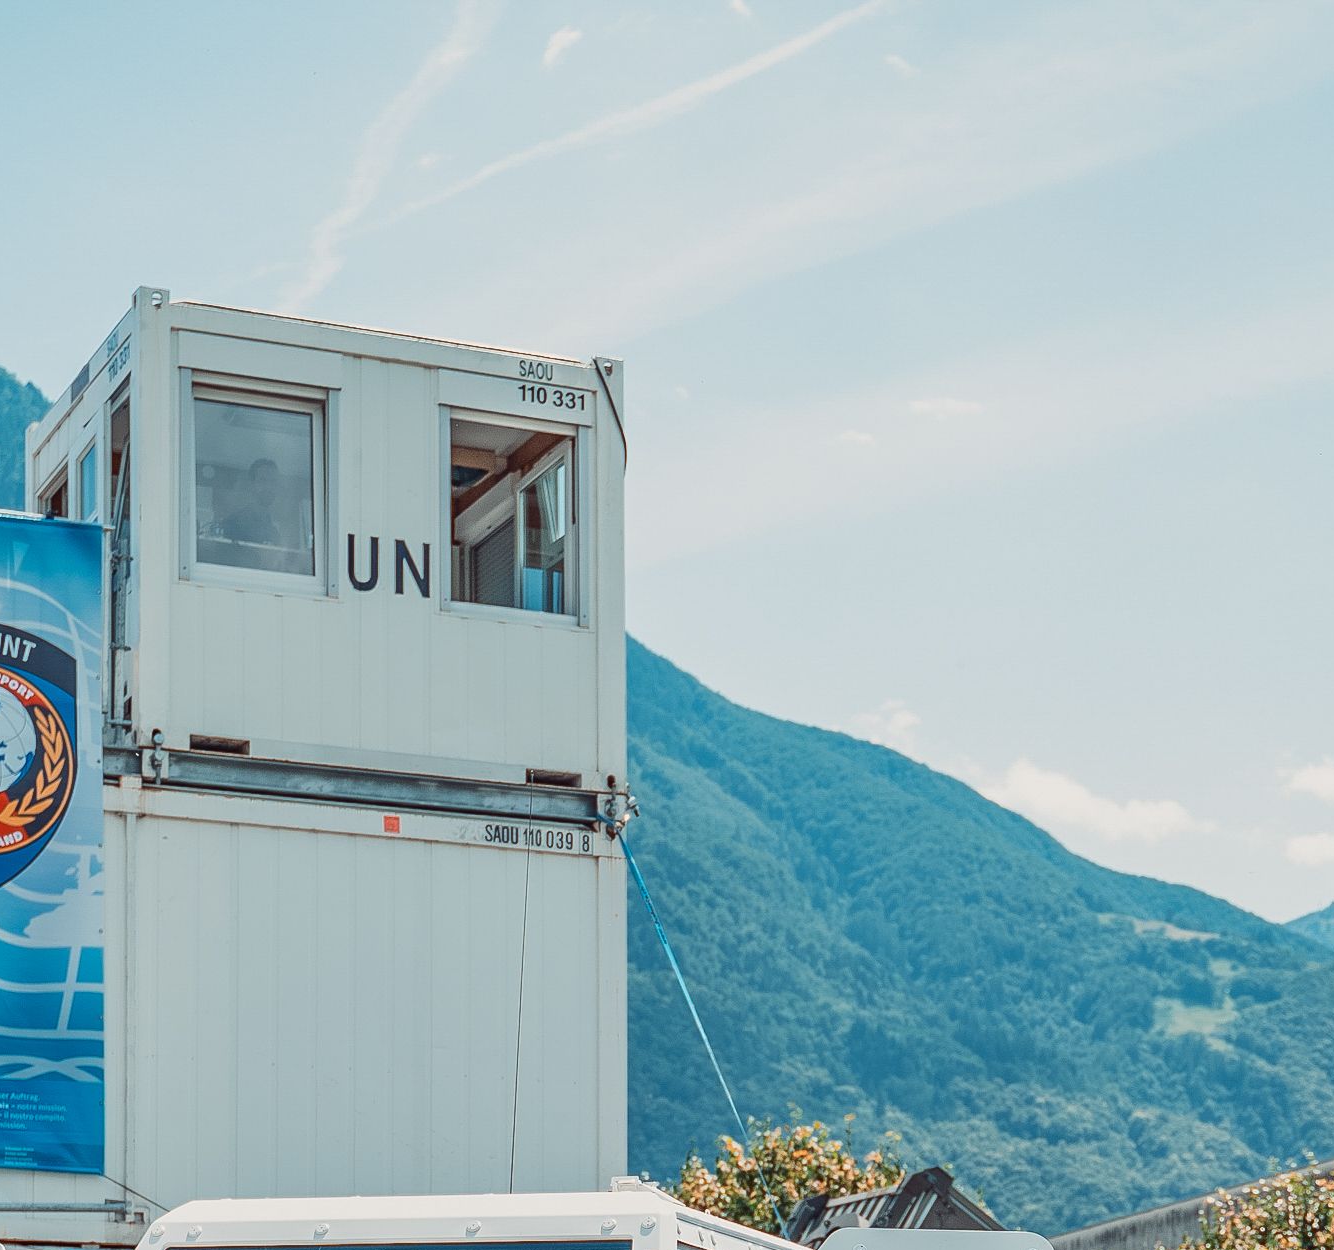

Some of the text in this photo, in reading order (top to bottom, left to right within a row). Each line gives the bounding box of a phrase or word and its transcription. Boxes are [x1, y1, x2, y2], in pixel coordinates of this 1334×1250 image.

[519, 360, 553, 381] SAOU
[518, 385, 585, 410] 110 331
[348, 534, 430, 598] UN
[485, 825, 589, 852] SAOU 110 039 8
